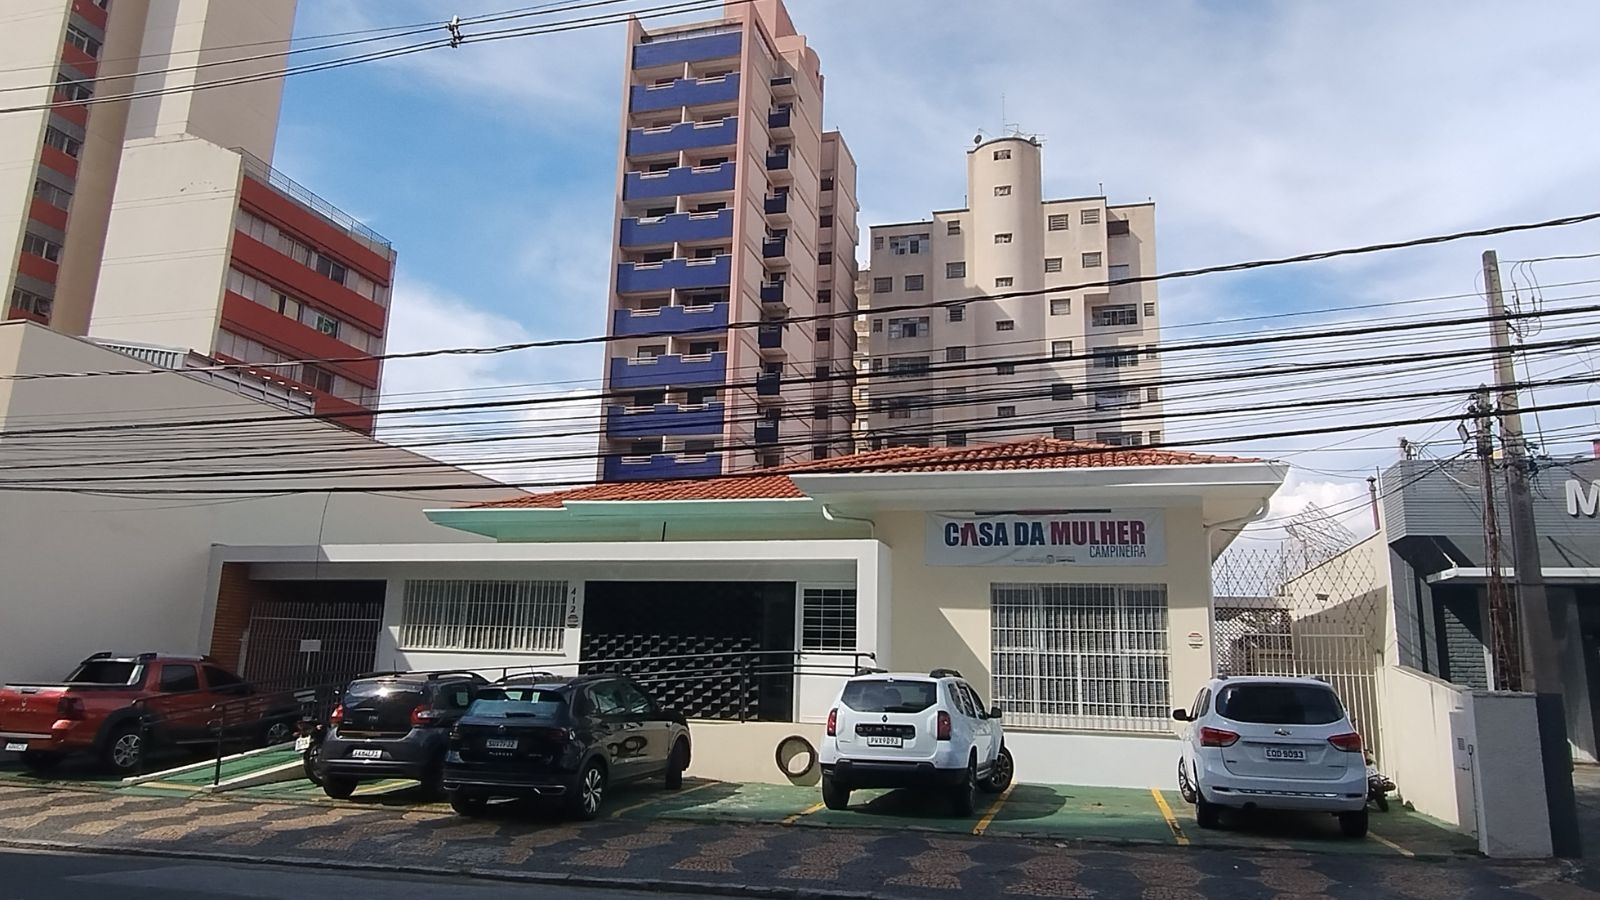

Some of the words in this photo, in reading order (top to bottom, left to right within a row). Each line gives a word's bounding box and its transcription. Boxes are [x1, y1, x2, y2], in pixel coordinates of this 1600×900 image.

[944, 522, 1009, 546] CASA
[1014, 522, 1045, 546] DA
[1051, 520, 1146, 545] MULHER
[1089, 545, 1146, 558] CAMPINEIRA
